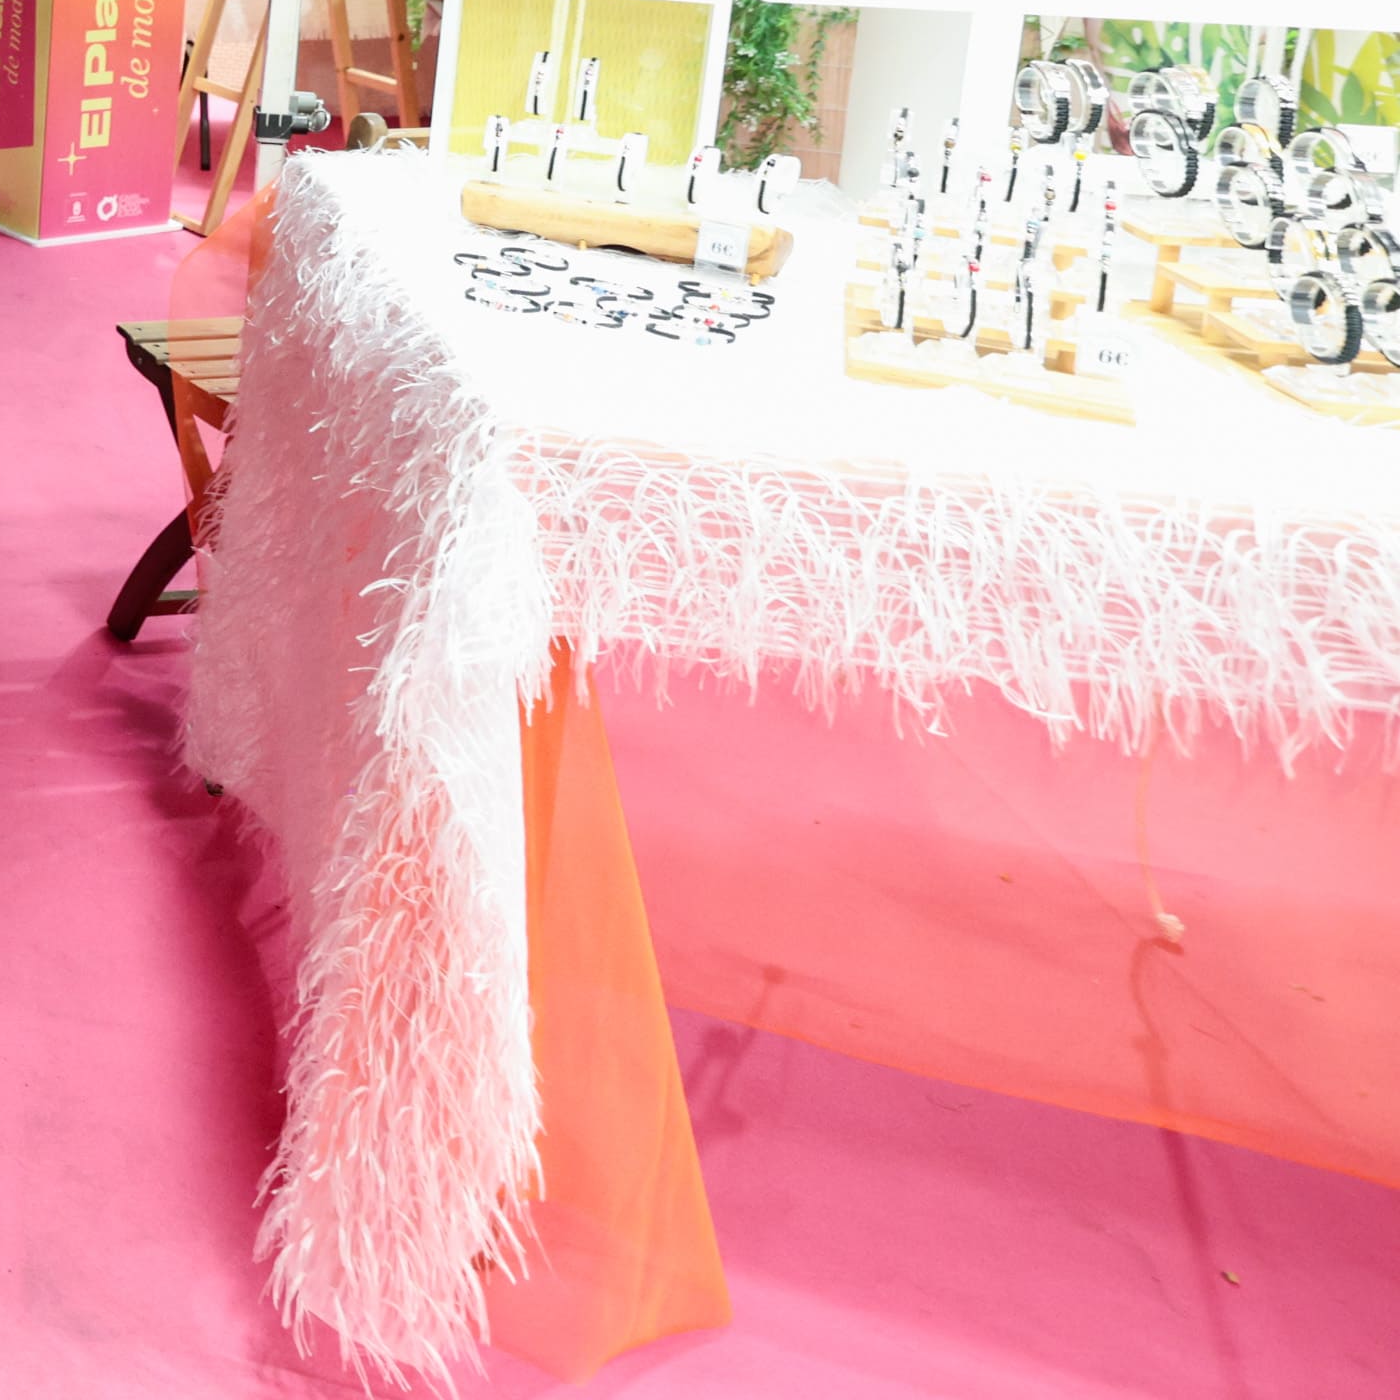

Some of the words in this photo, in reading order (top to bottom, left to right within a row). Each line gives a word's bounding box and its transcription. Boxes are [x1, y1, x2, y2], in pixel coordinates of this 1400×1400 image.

[3, 55, 20, 85] de
[121, 58, 150, 98] de
[80, 97, 113, 149] El
[1098, 349, 1129, 367] 6€
